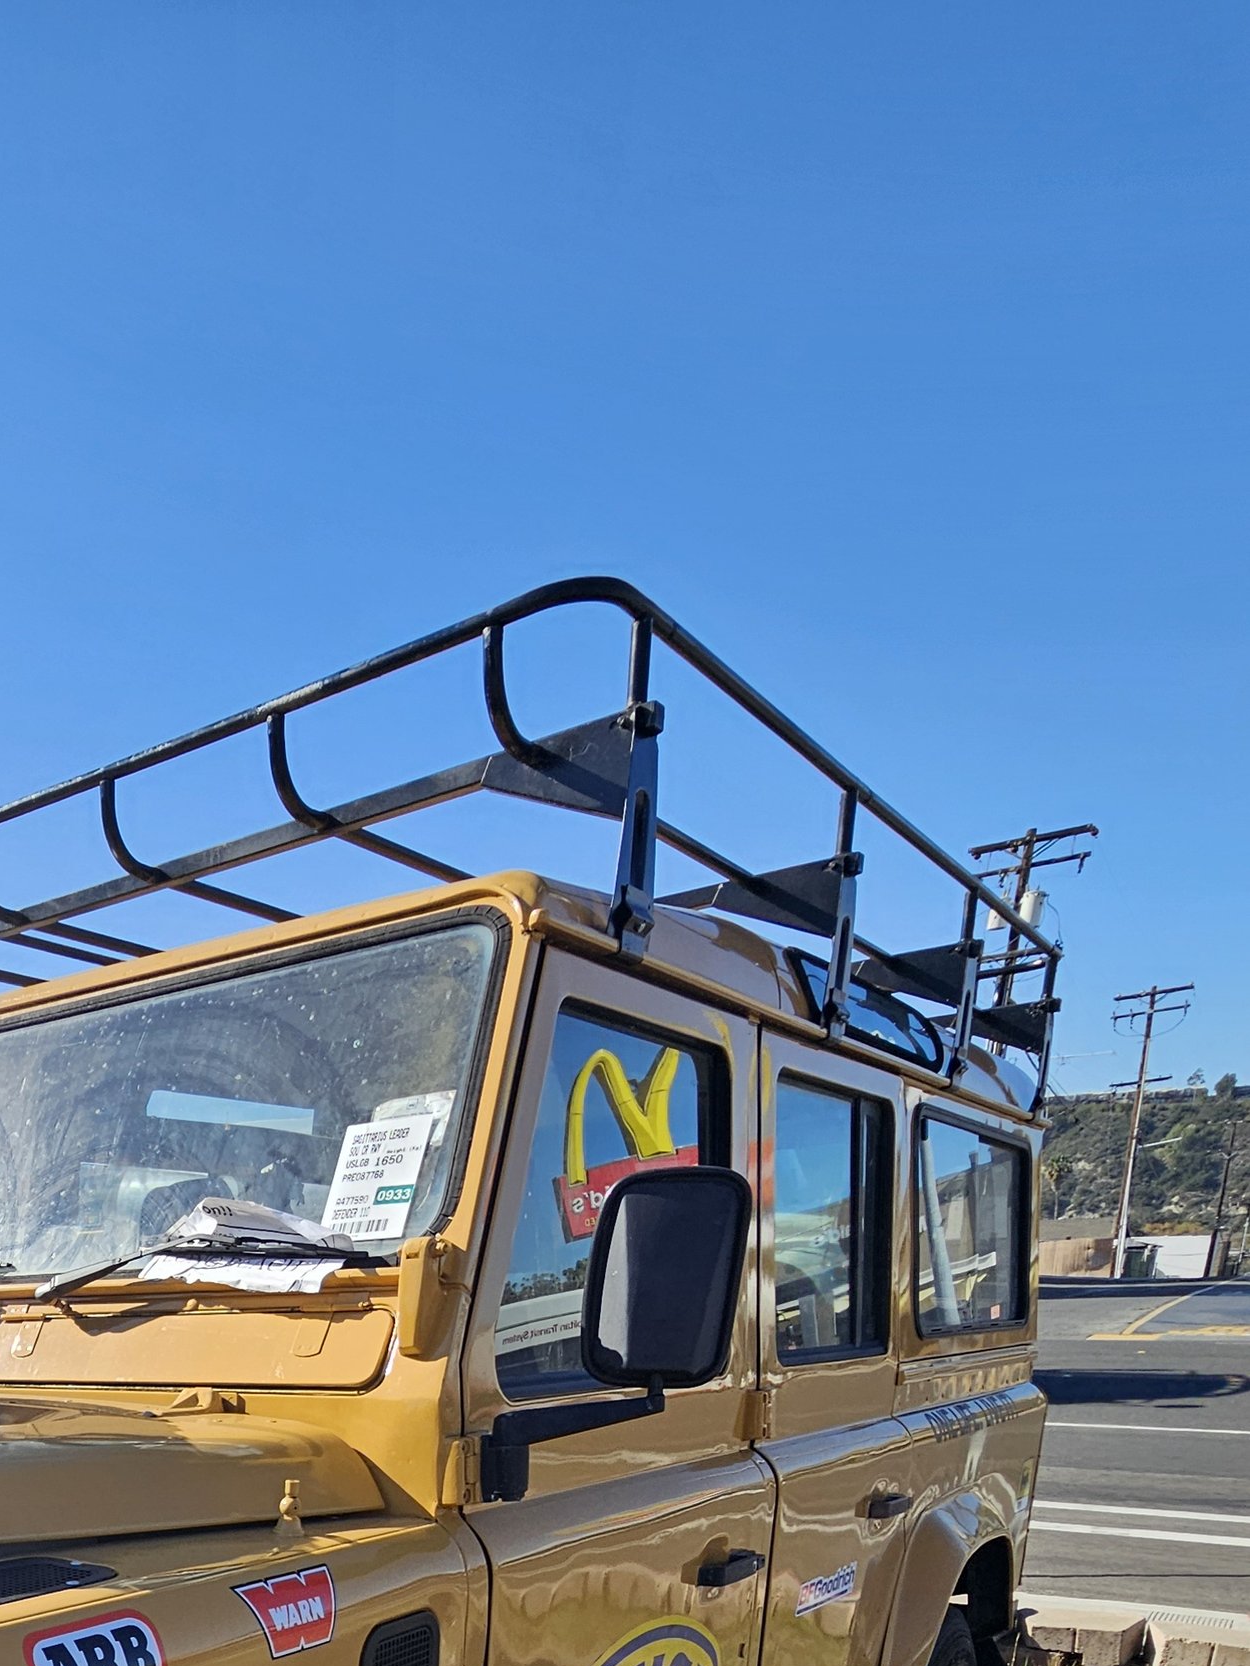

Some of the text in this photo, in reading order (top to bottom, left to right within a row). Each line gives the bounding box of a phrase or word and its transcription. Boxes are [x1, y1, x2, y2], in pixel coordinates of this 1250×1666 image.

[389, 1127, 411, 1140] LEADER
[374, 1154, 404, 1167] 1650
[376, 1188, 411, 1201] 0933
[268, 1596, 325, 1631] WARN
